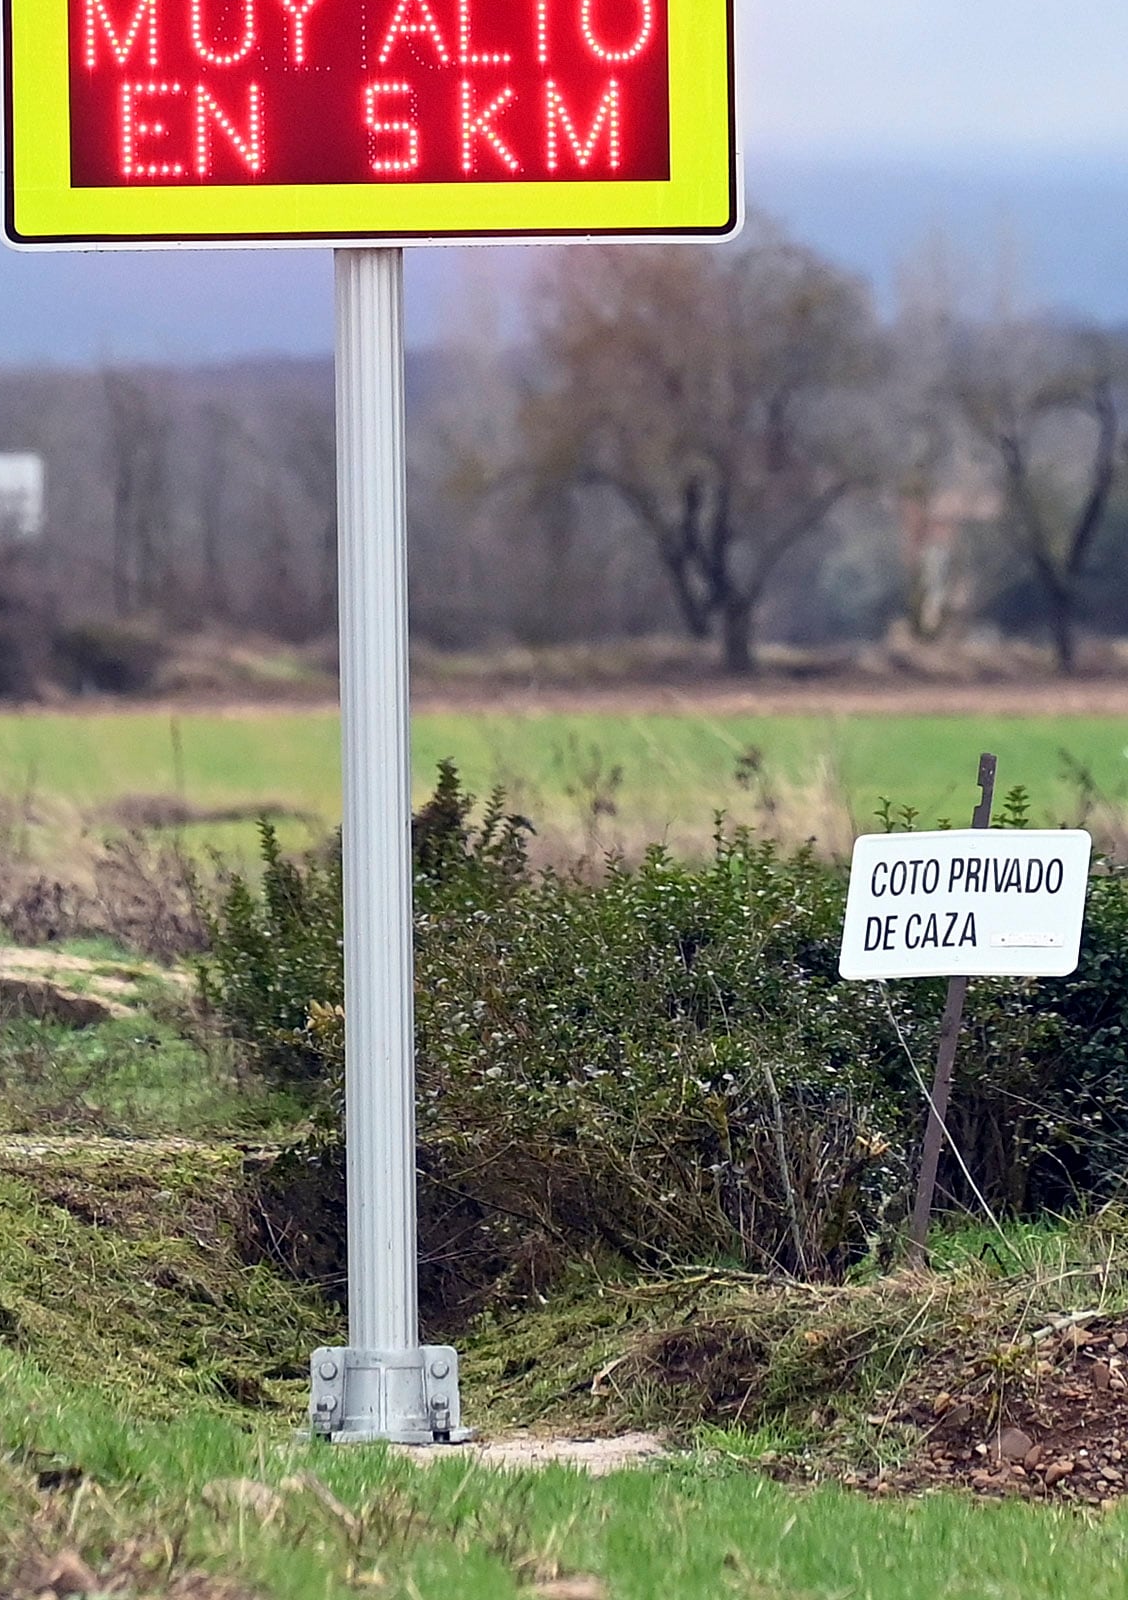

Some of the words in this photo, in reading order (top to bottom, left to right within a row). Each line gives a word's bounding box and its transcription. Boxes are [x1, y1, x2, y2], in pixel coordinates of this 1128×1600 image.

[121, 83, 263, 175] EN
[461, 80, 621, 173] KM
[871, 858, 940, 898] COTO
[948, 857, 1064, 894] PRIVADO
[863, 914, 898, 952] DE
[904, 911, 977, 950] CAZA
